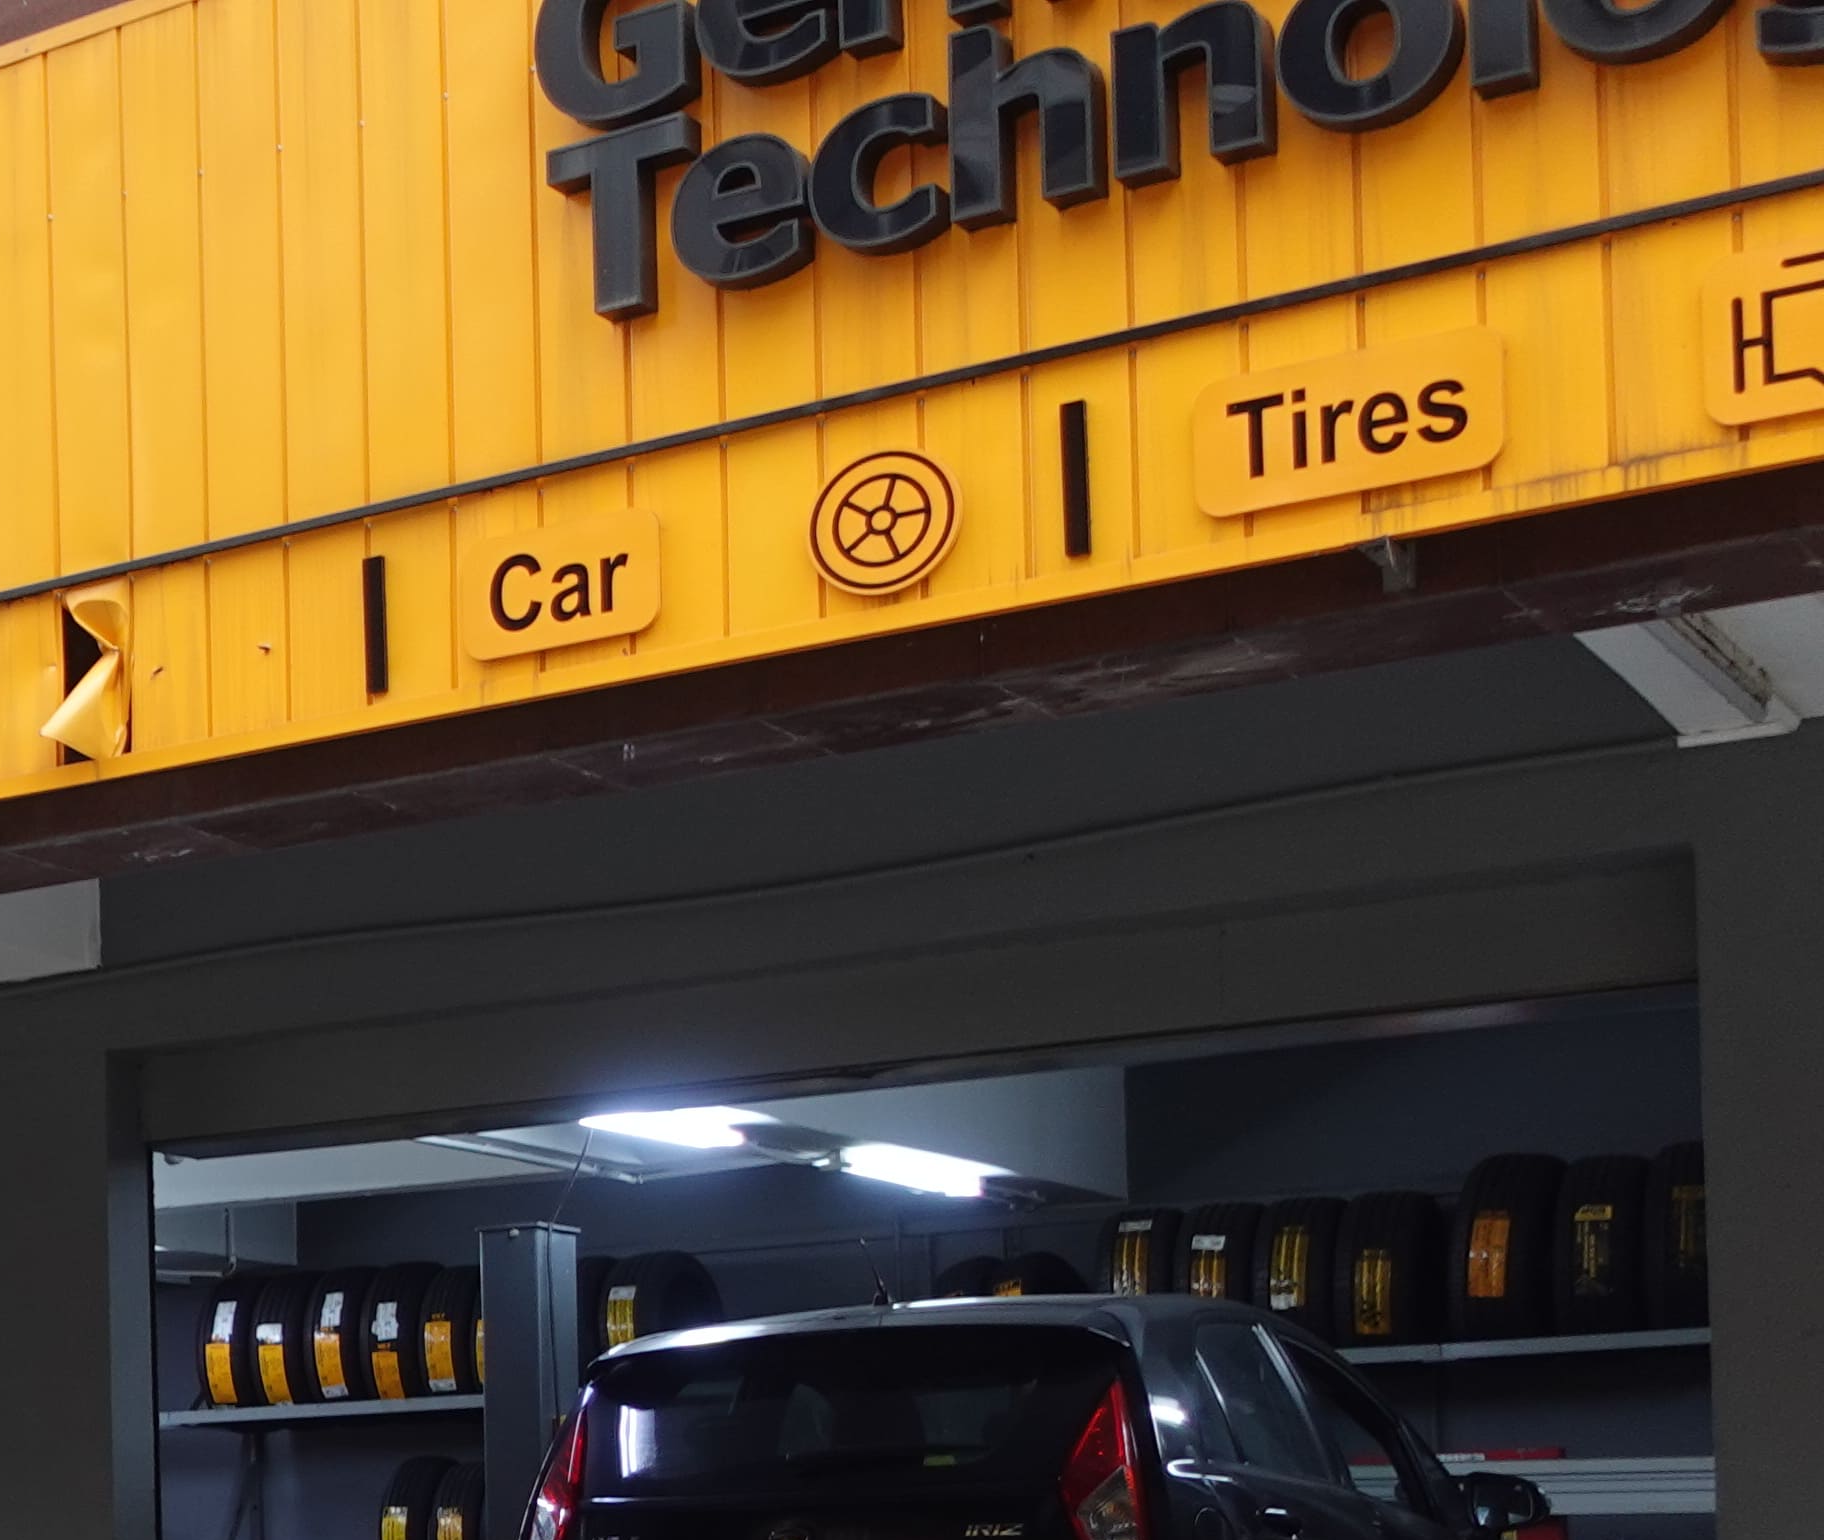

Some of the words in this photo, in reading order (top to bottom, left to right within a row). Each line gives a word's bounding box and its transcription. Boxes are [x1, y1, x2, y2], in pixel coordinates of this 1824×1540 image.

[1225, 378, 1470, 481] Tires
[489, 552, 630, 633] Car
[964, 1522, 1025, 1538] IRIZ
